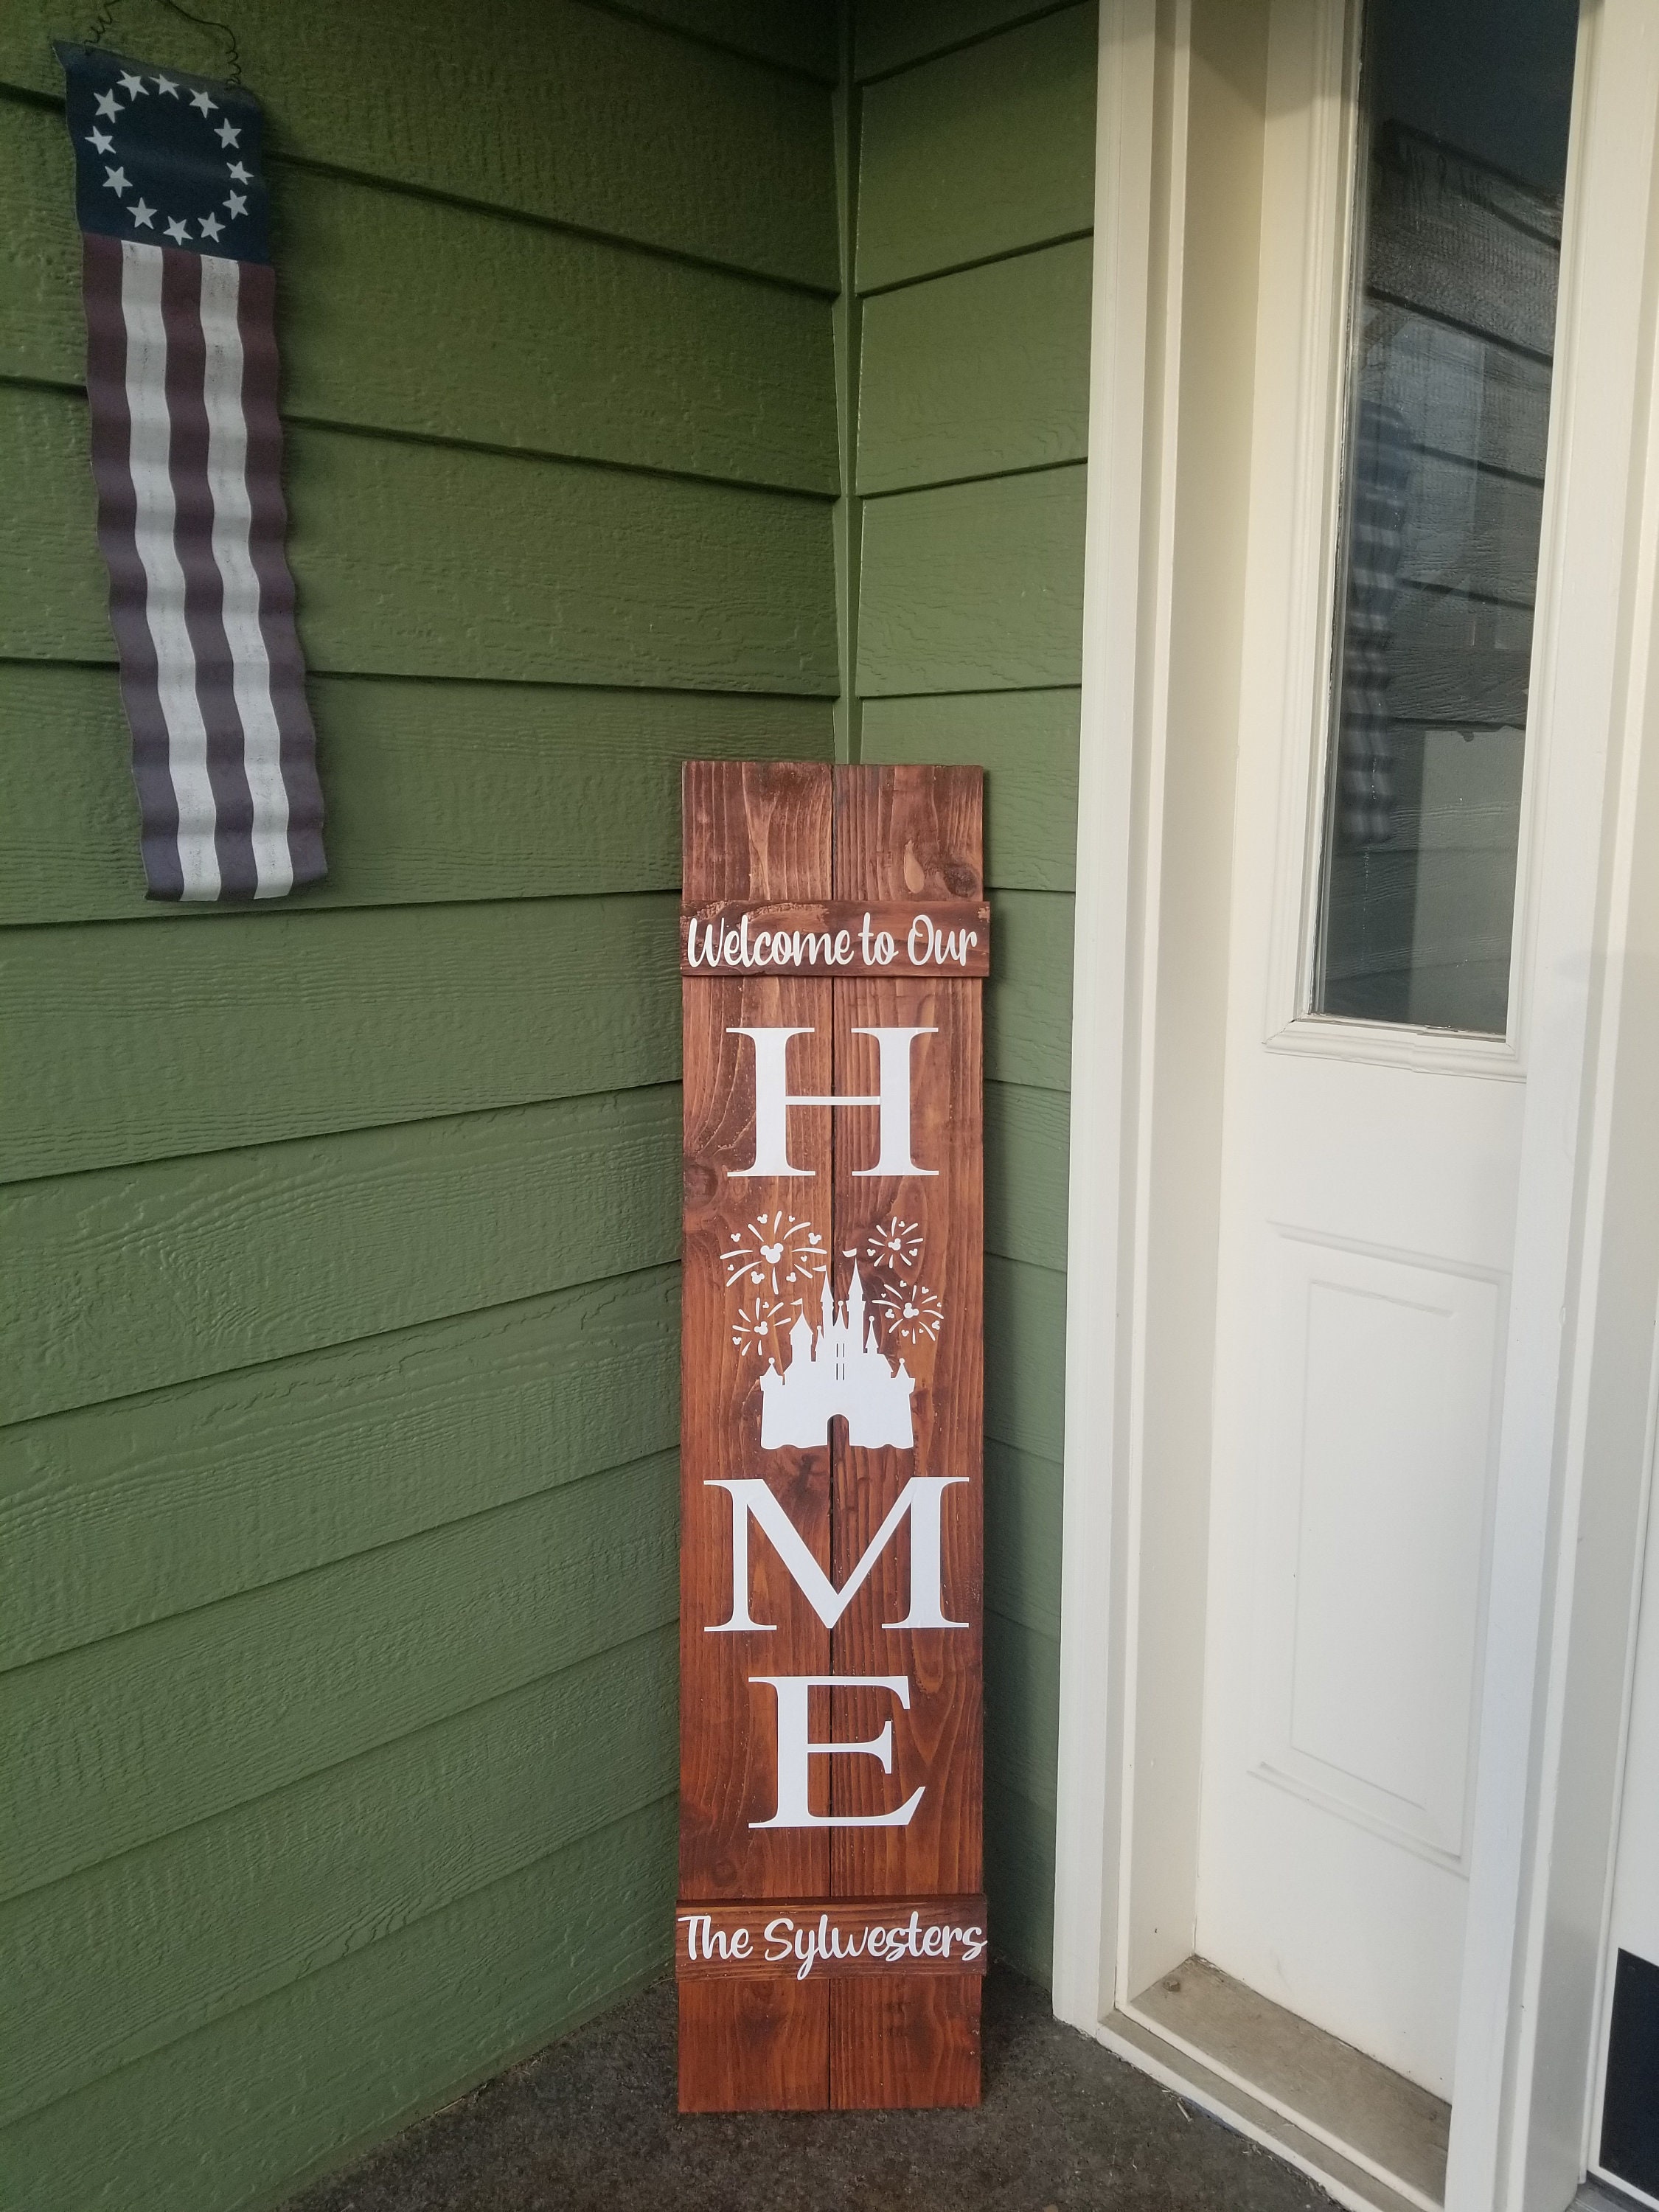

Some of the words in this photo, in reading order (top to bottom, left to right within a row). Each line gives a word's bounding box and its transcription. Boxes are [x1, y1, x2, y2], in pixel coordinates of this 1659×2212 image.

[686, 917, 855, 968] Welcome
[858, 911, 900, 966] to
[907, 914, 978, 966] Our
[677, 1915, 754, 1961] The
[764, 1910, 988, 1980] Sylwesters
